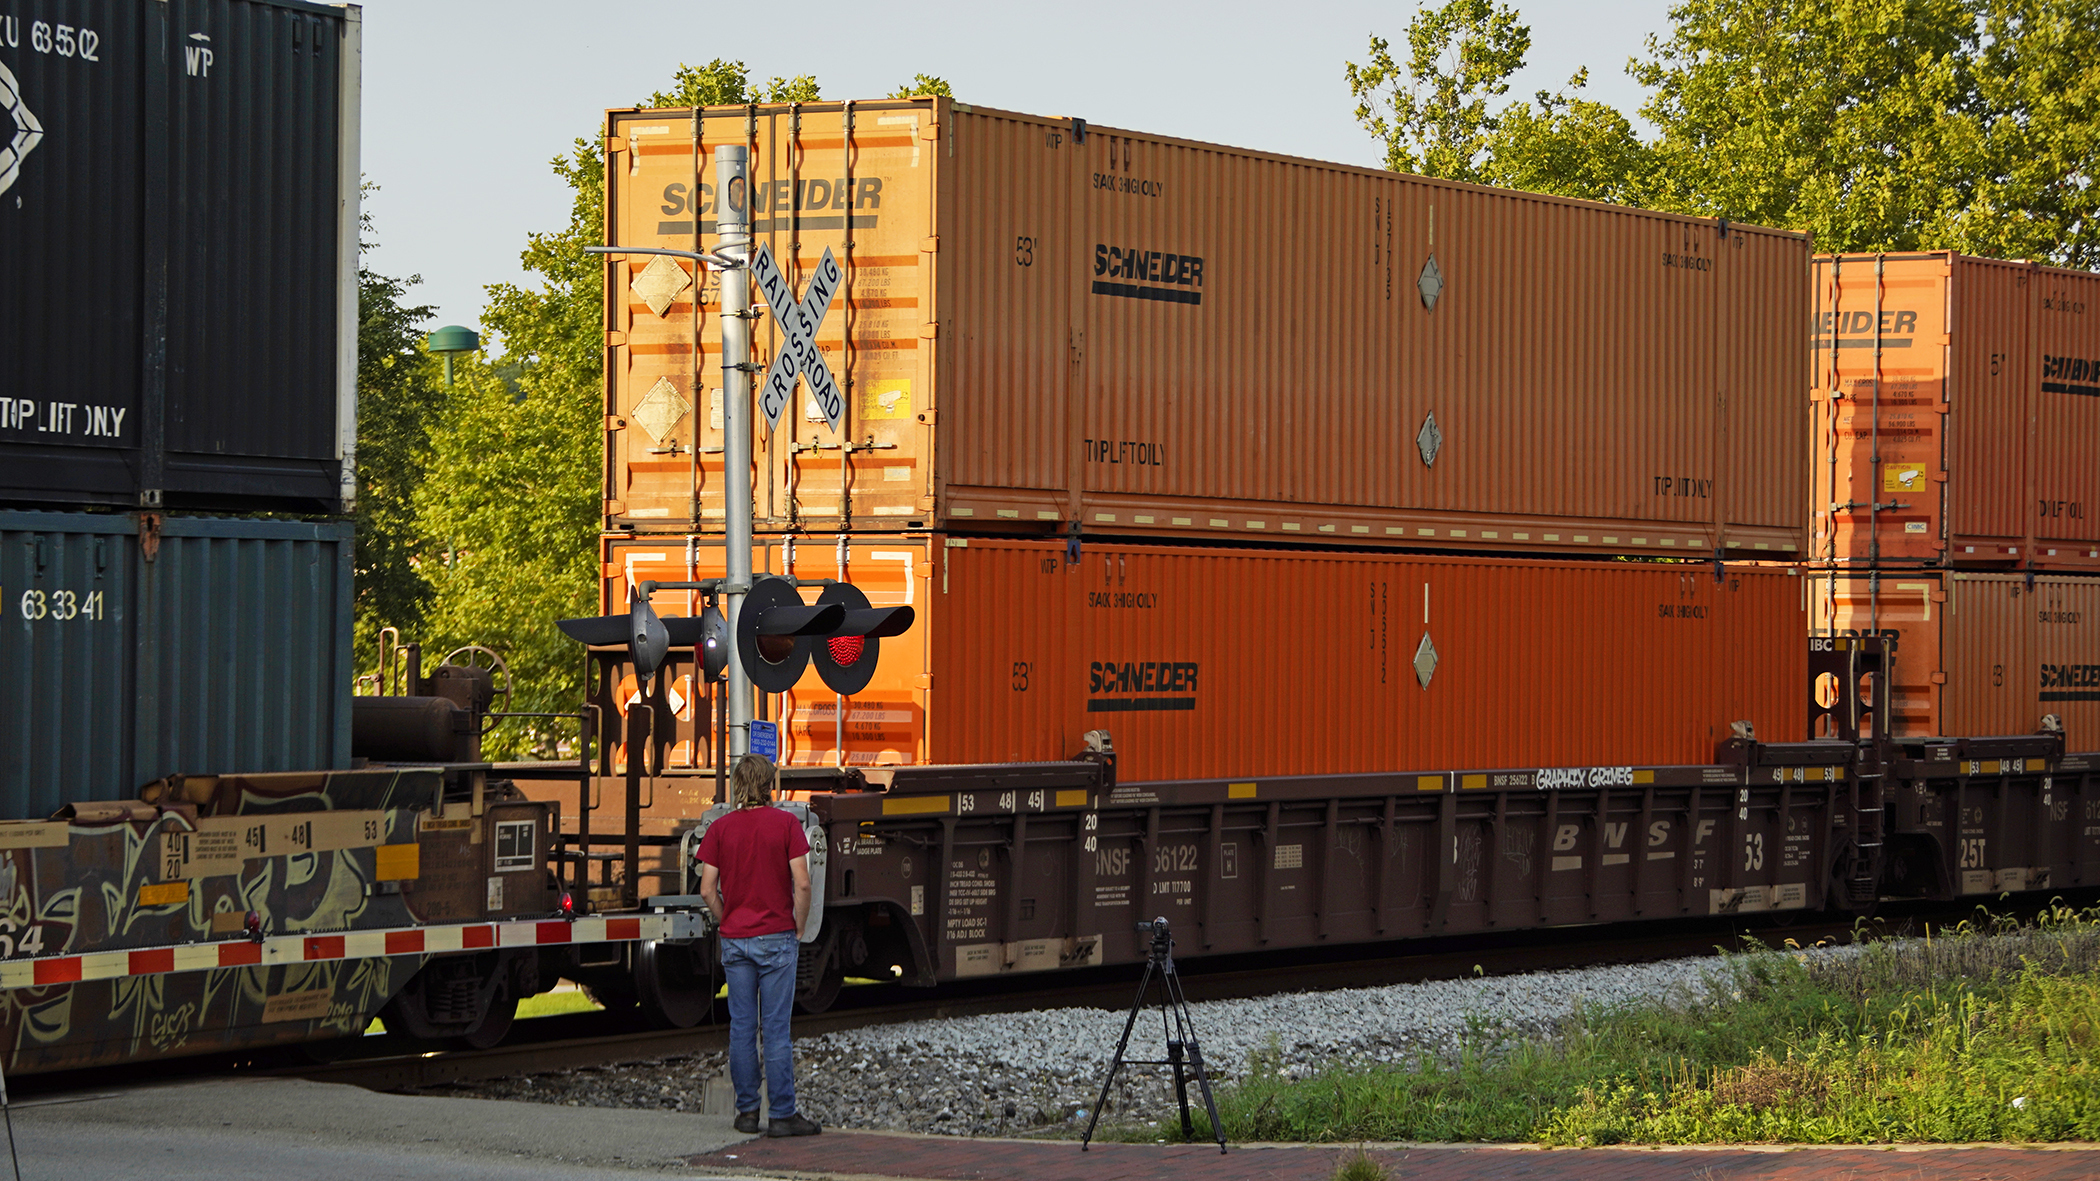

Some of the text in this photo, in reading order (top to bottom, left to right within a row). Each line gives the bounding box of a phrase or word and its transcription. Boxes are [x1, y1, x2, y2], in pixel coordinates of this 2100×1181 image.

[660, 176, 882, 216] SCNEIDER
[1093, 243, 1204, 287] SCHNEIDER
[763, 257, 839, 421] CROSSING
[1810, 638, 1833, 652] IBC
[1088, 661, 1198, 694] SCHNEIDER
[961, 793, 975, 812] 53
[999, 792, 1012, 810] 48
[1028, 790, 1041, 808] 45
[364, 820, 377, 840] 53
[1085, 814, 1097, 831] 20
[167, 833, 180, 852] 40
[245, 827, 259, 848] 45
[291, 825, 305, 845] 48
[1084, 836, 1097, 853] 40
[1960, 838, 1986, 869] 25T
[167, 859, 180, 879] 20
